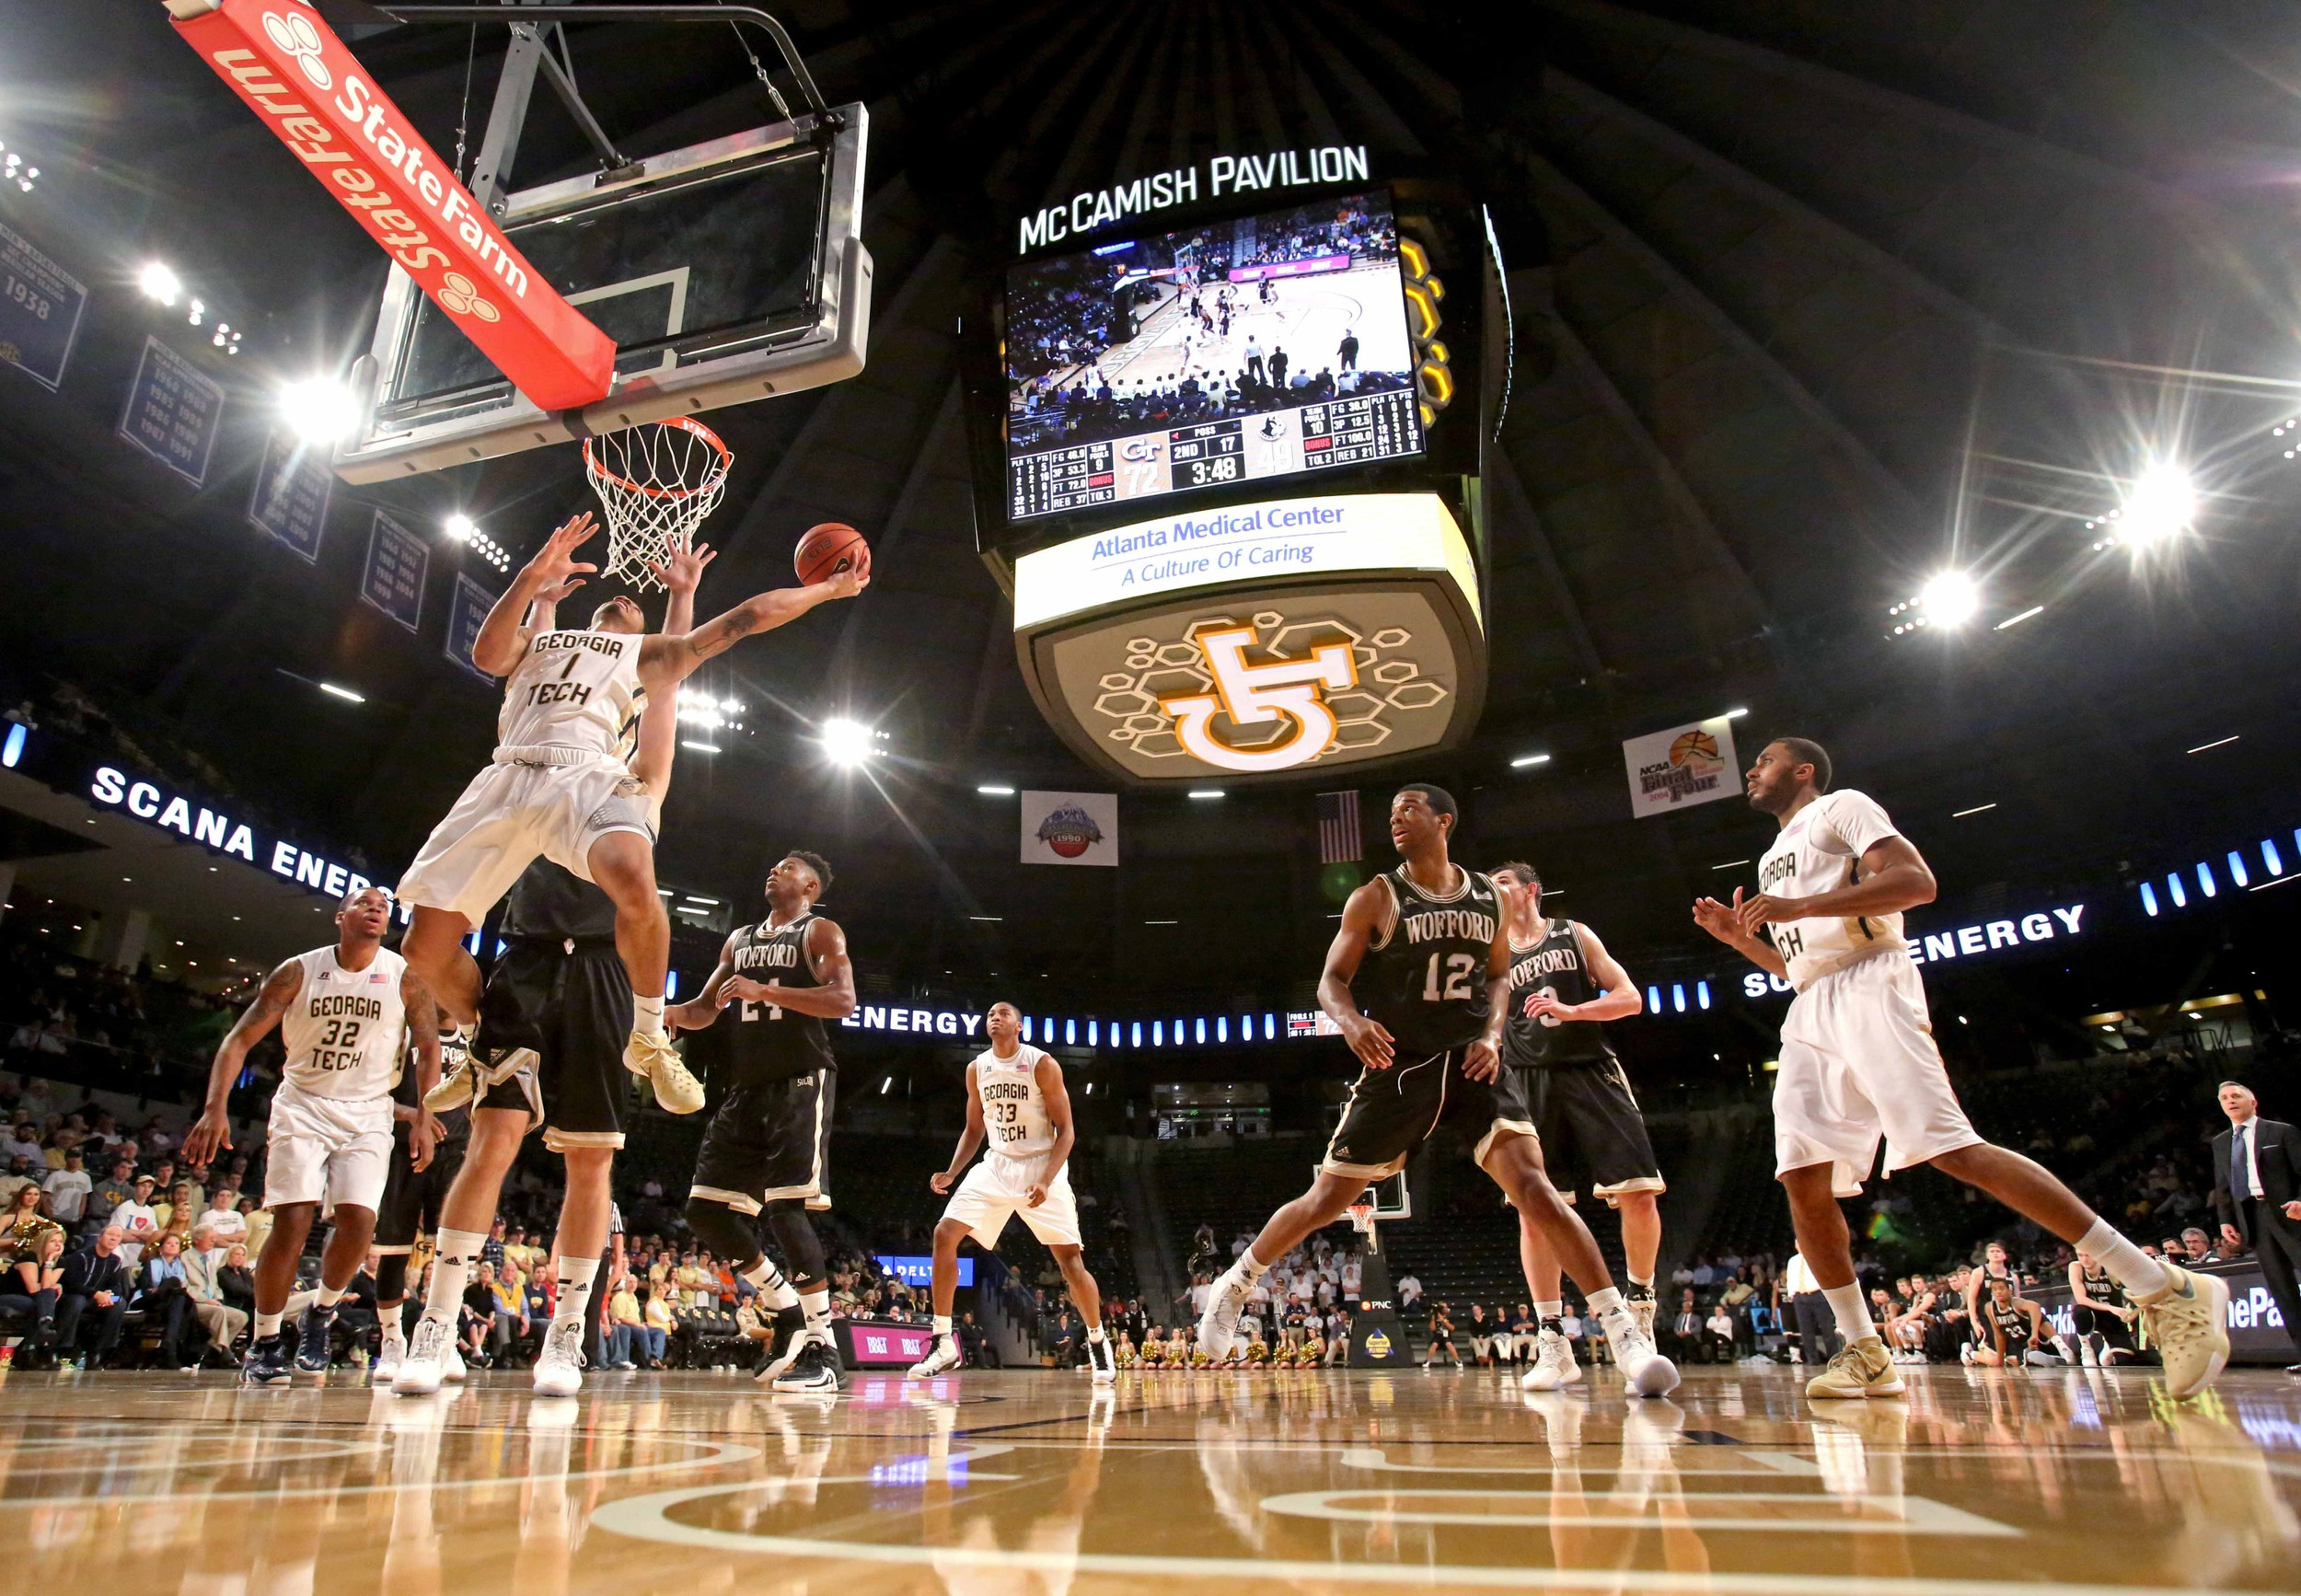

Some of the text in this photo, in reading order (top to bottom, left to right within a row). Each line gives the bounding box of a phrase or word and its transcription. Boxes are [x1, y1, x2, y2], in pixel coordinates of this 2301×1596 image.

[1211, 145, 1369, 197] PAVILION
[3, 272, 52, 323] 1938
[1371, 396, 1385, 405] PLR
[1399, 391, 1413, 400] PTS
[1332, 404, 1345, 414] FG
[1377, 399, 1412, 414] 1 0 0
[1334, 415, 1370, 430] 3P 12.5
[1378, 410, 1413, 424] 3 2 4
[1194, 426, 1216, 437] POSS
[1310, 421, 1324, 434] 10
[1377, 420, 1415, 434] 12 3 5
[1304, 437, 1331, 451] BONUS
[1335, 431, 1371, 445] FT 100.0
[1377, 430, 1418, 445] 24 3 12
[1121, 438, 1162, 461] GT
[1174, 436, 1235, 459] 2ND 17
[1337, 446, 1373, 461] REB 21
[1378, 445, 1390, 456] 31
[1395, 443, 1402, 453] 3
[1012, 459, 1023, 468] PLR
[1036, 455, 1048, 463] PTS
[1052, 452, 1065, 463] FG
[1095, 458, 1104, 471] 9
[1307, 453, 1332, 466] TOL 2
[1016, 463, 1047, 476] 1 2 5
[1052, 463, 1085, 478] 3P 53.3
[1192, 457, 1237, 484] 3:48
[1016, 477, 1022, 486] 2
[1029, 474, 1035, 484] 2
[1053, 479, 1086, 493] FT 72.0
[1089, 474, 1113, 486] BONUS
[1124, 462, 1161, 496] 72
[1016, 486, 1023, 495] 3
[1030, 484, 1035, 492] 1
[1090, 490, 1112, 502] TOL 3
[1013, 492, 1047, 506] 32 3 4
[1053, 494, 1086, 508] REB 37
[1014, 501, 1048, 515] 33 1 4
[1092, 506, 1345, 561] Atlanta Medical Center
[1121, 544, 1314, 586] A Culture Of Caring
[535, 633, 623, 659] GEORGIA
[561, 653, 582, 679] 1
[527, 683, 592, 706] TECH
[1640, 761, 1671, 776] NCAA
[1640, 764, 1693, 794] Final
[1668, 774, 1718, 803] Four
[1648, 791, 1670, 802] 2004
[91, 767, 254, 862] SCANA
[1057, 834, 1081, 842] 1990
[1404, 909, 1496, 944] WOFFORD
[1907, 904, 2084, 965] ENERGY
[734, 943, 798, 973] WOFFORD
[1423, 952, 1475, 1002] 12
[310, 996, 381, 1021] GEORGIA
[841, 1005, 981, 1035] ENERGY
[321, 1019, 360, 1047] 32
[312, 1048, 363, 1071] TECH
[984, 1083, 1028, 1102] GEORGIA
[997, 1103, 1017, 1123] 33
[996, 1125, 1026, 1142] TECH
[1371, 1301, 1392, 1309] PNC
